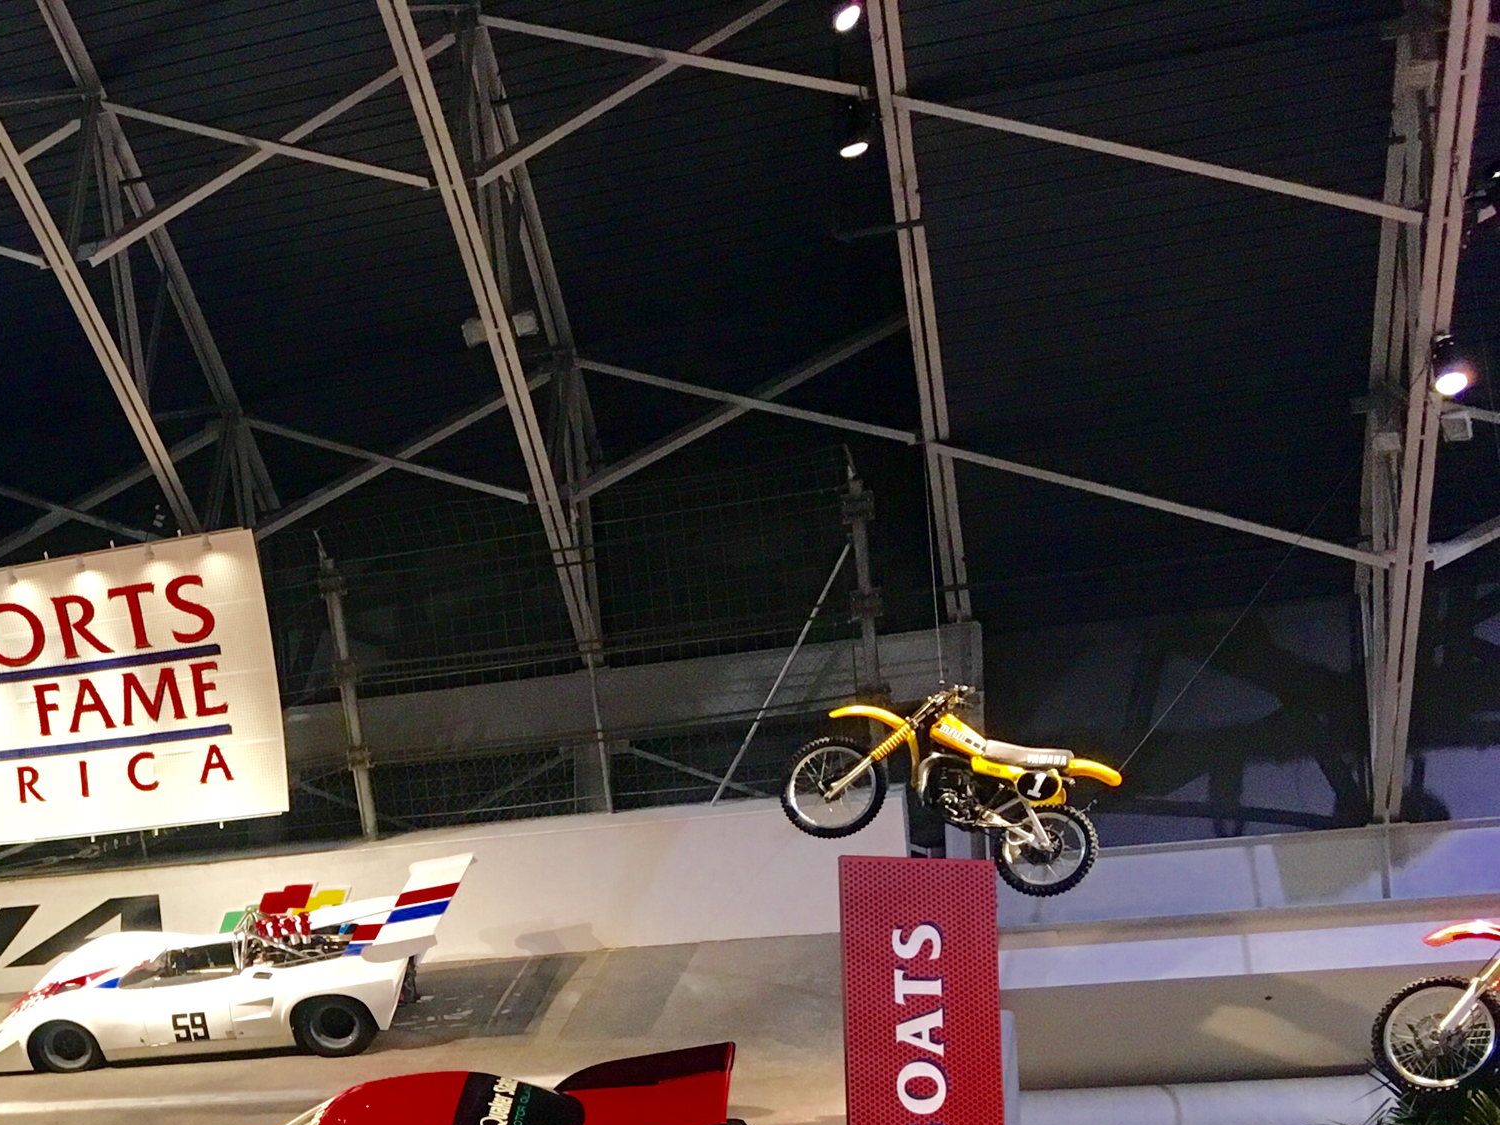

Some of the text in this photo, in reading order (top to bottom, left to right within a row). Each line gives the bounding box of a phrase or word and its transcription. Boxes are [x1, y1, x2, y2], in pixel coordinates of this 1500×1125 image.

[34, 661, 229, 737] FAME
[1026, 772, 1047, 798] 1
[171, 1012, 209, 1042] 59
